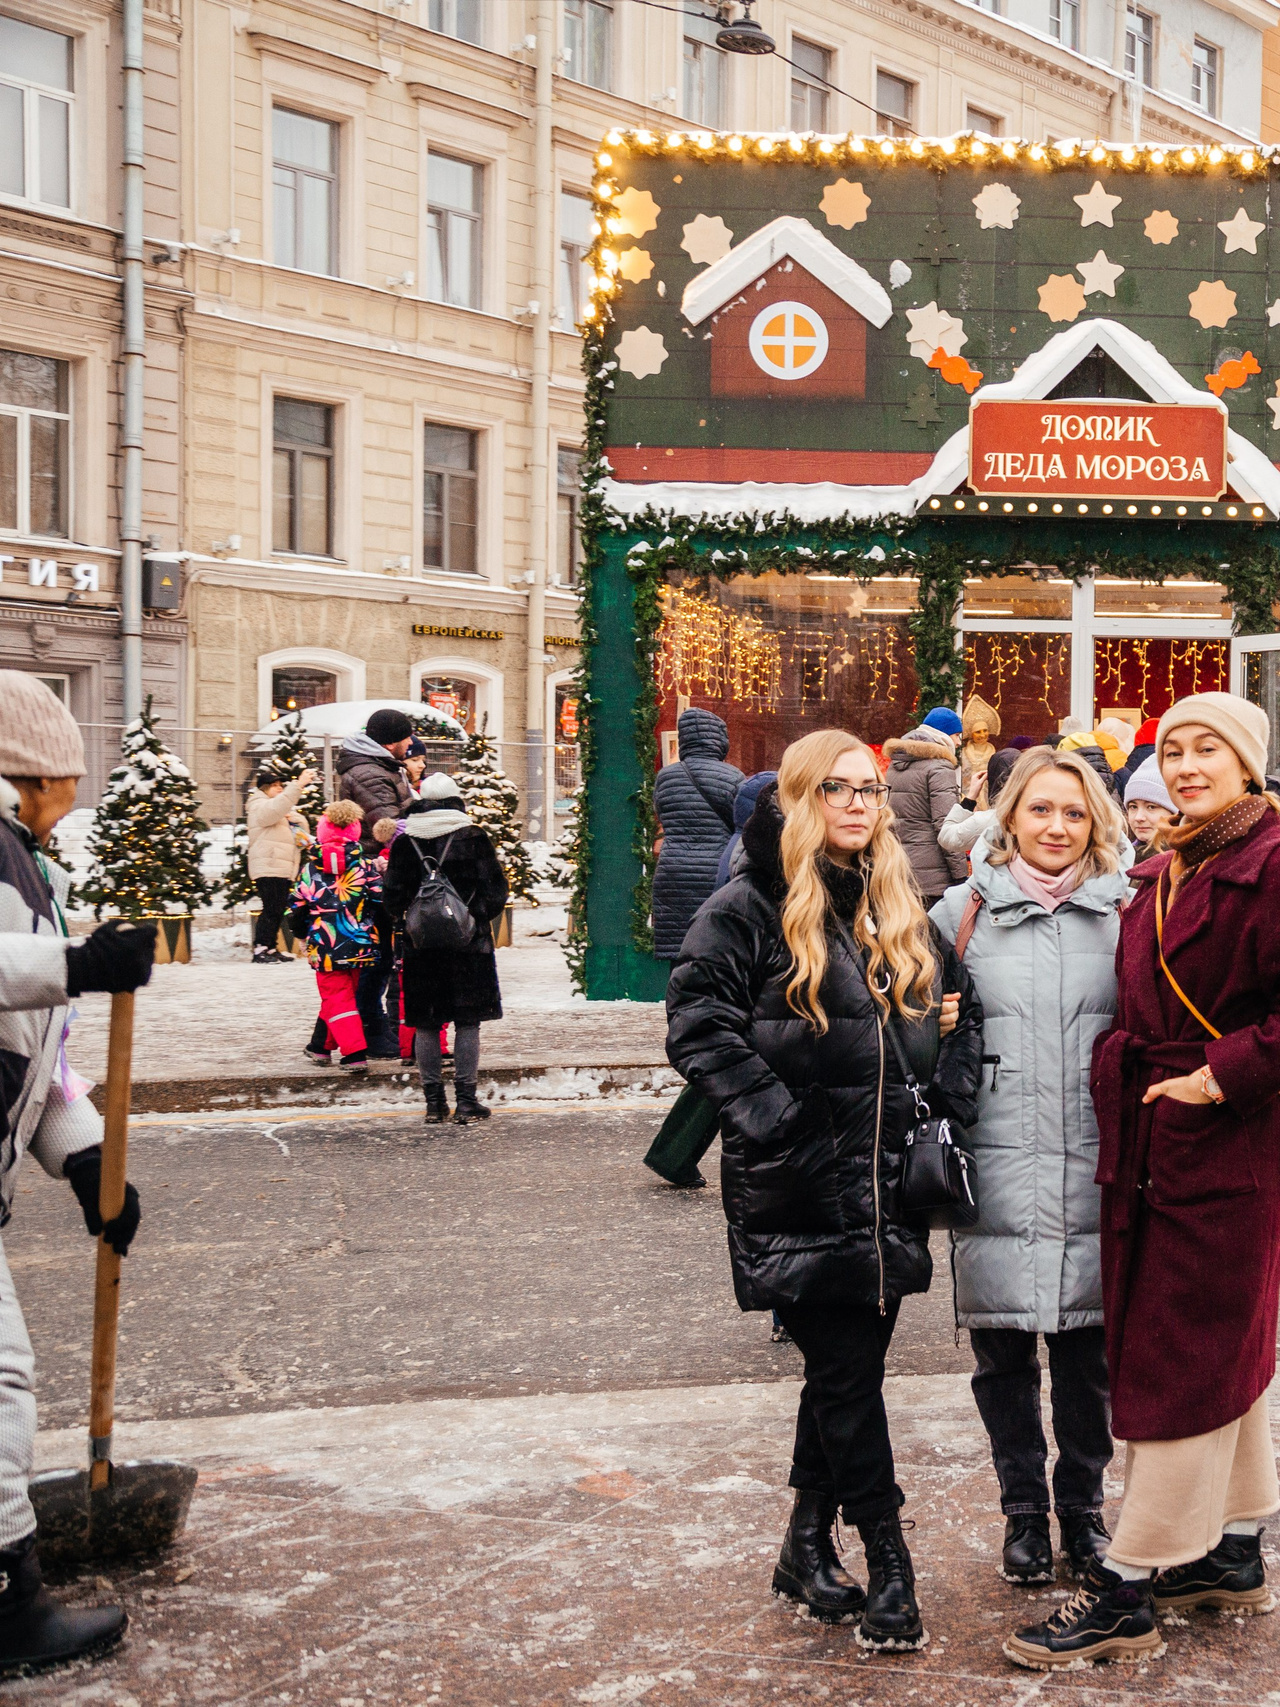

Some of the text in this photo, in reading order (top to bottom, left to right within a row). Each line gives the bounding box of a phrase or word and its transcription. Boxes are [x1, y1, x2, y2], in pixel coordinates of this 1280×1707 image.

[1041, 414, 1162, 447] ДОМИК
[984, 452, 1211, 483] ДЕДА МОРОЗА
[414, 624, 504, 640] ЕВРОПЕЙСКАЯ
[544, 635, 584, 647] ЯПОНС
